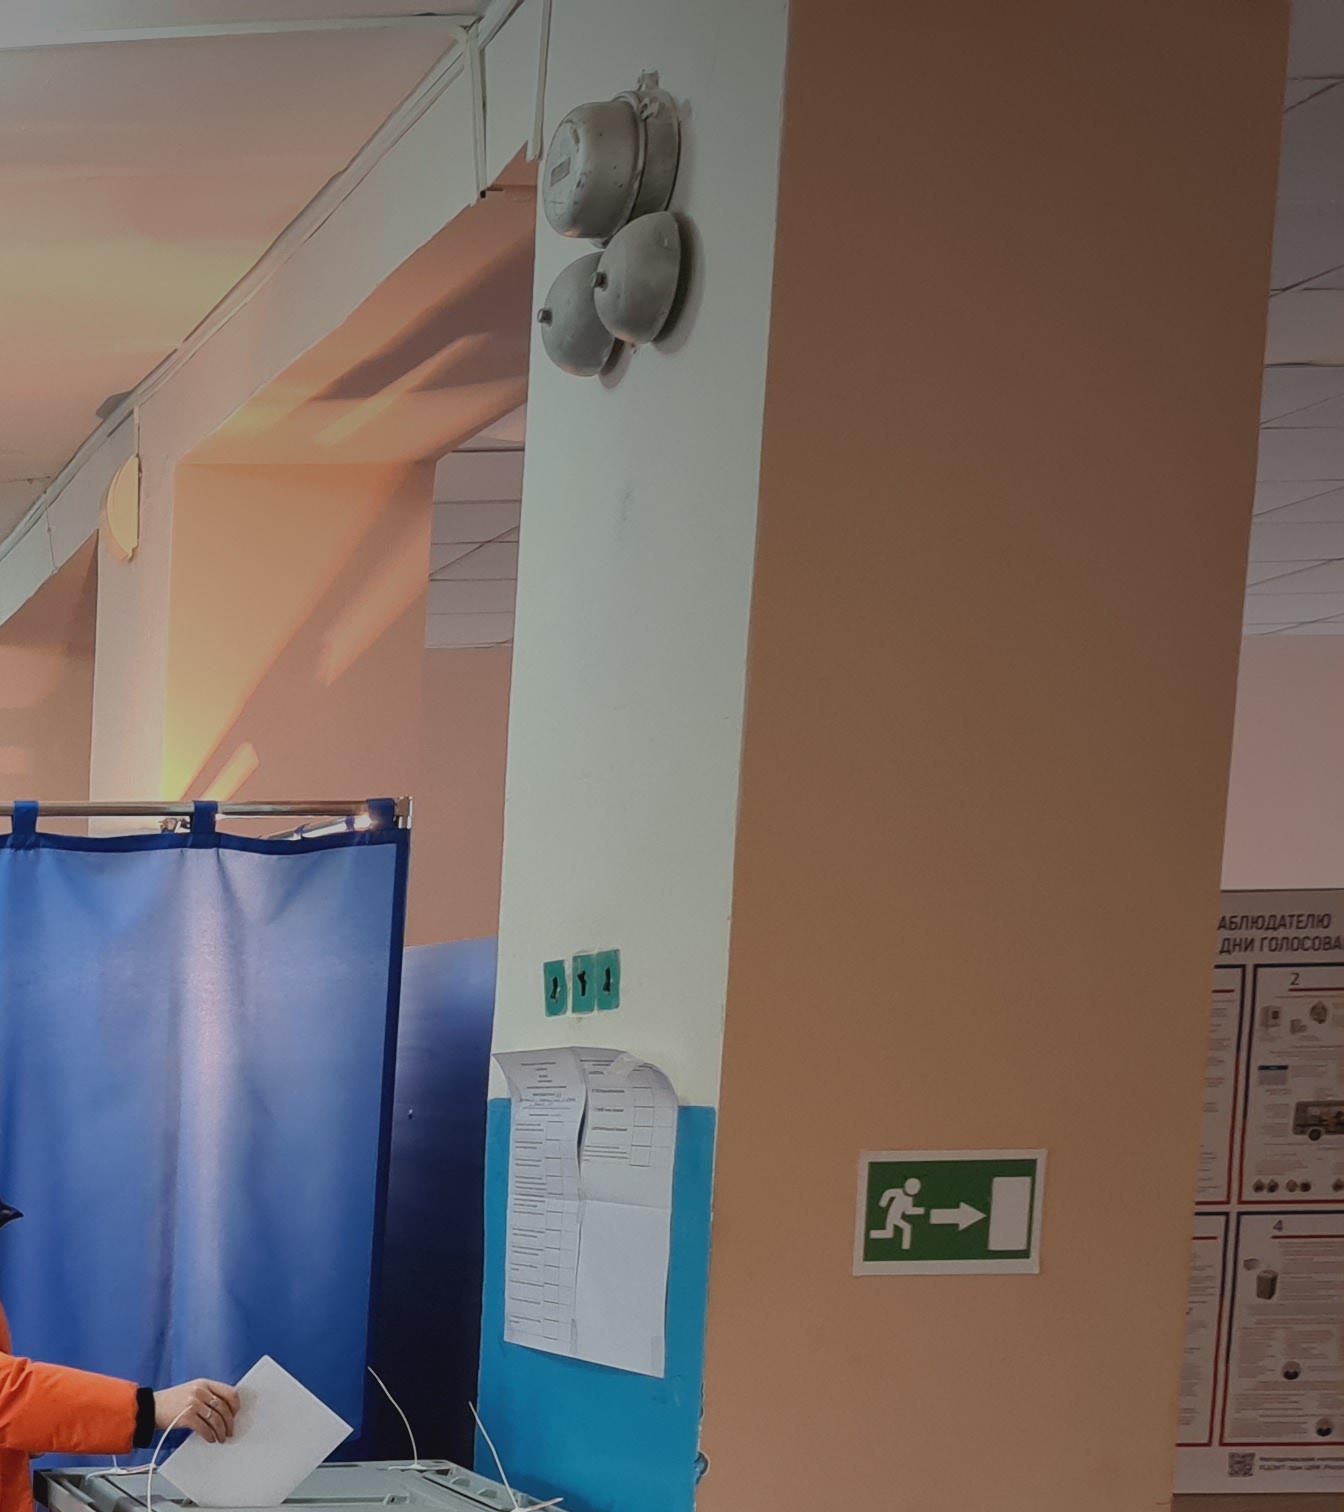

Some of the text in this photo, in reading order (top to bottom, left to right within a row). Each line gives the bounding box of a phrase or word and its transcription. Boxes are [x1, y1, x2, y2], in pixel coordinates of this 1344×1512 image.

[1219, 935, 1344, 955] ДНИ ГОЛОСОВА
[1290, 972, 1300, 986] 2
[1272, 1219, 1283, 1232] 4
